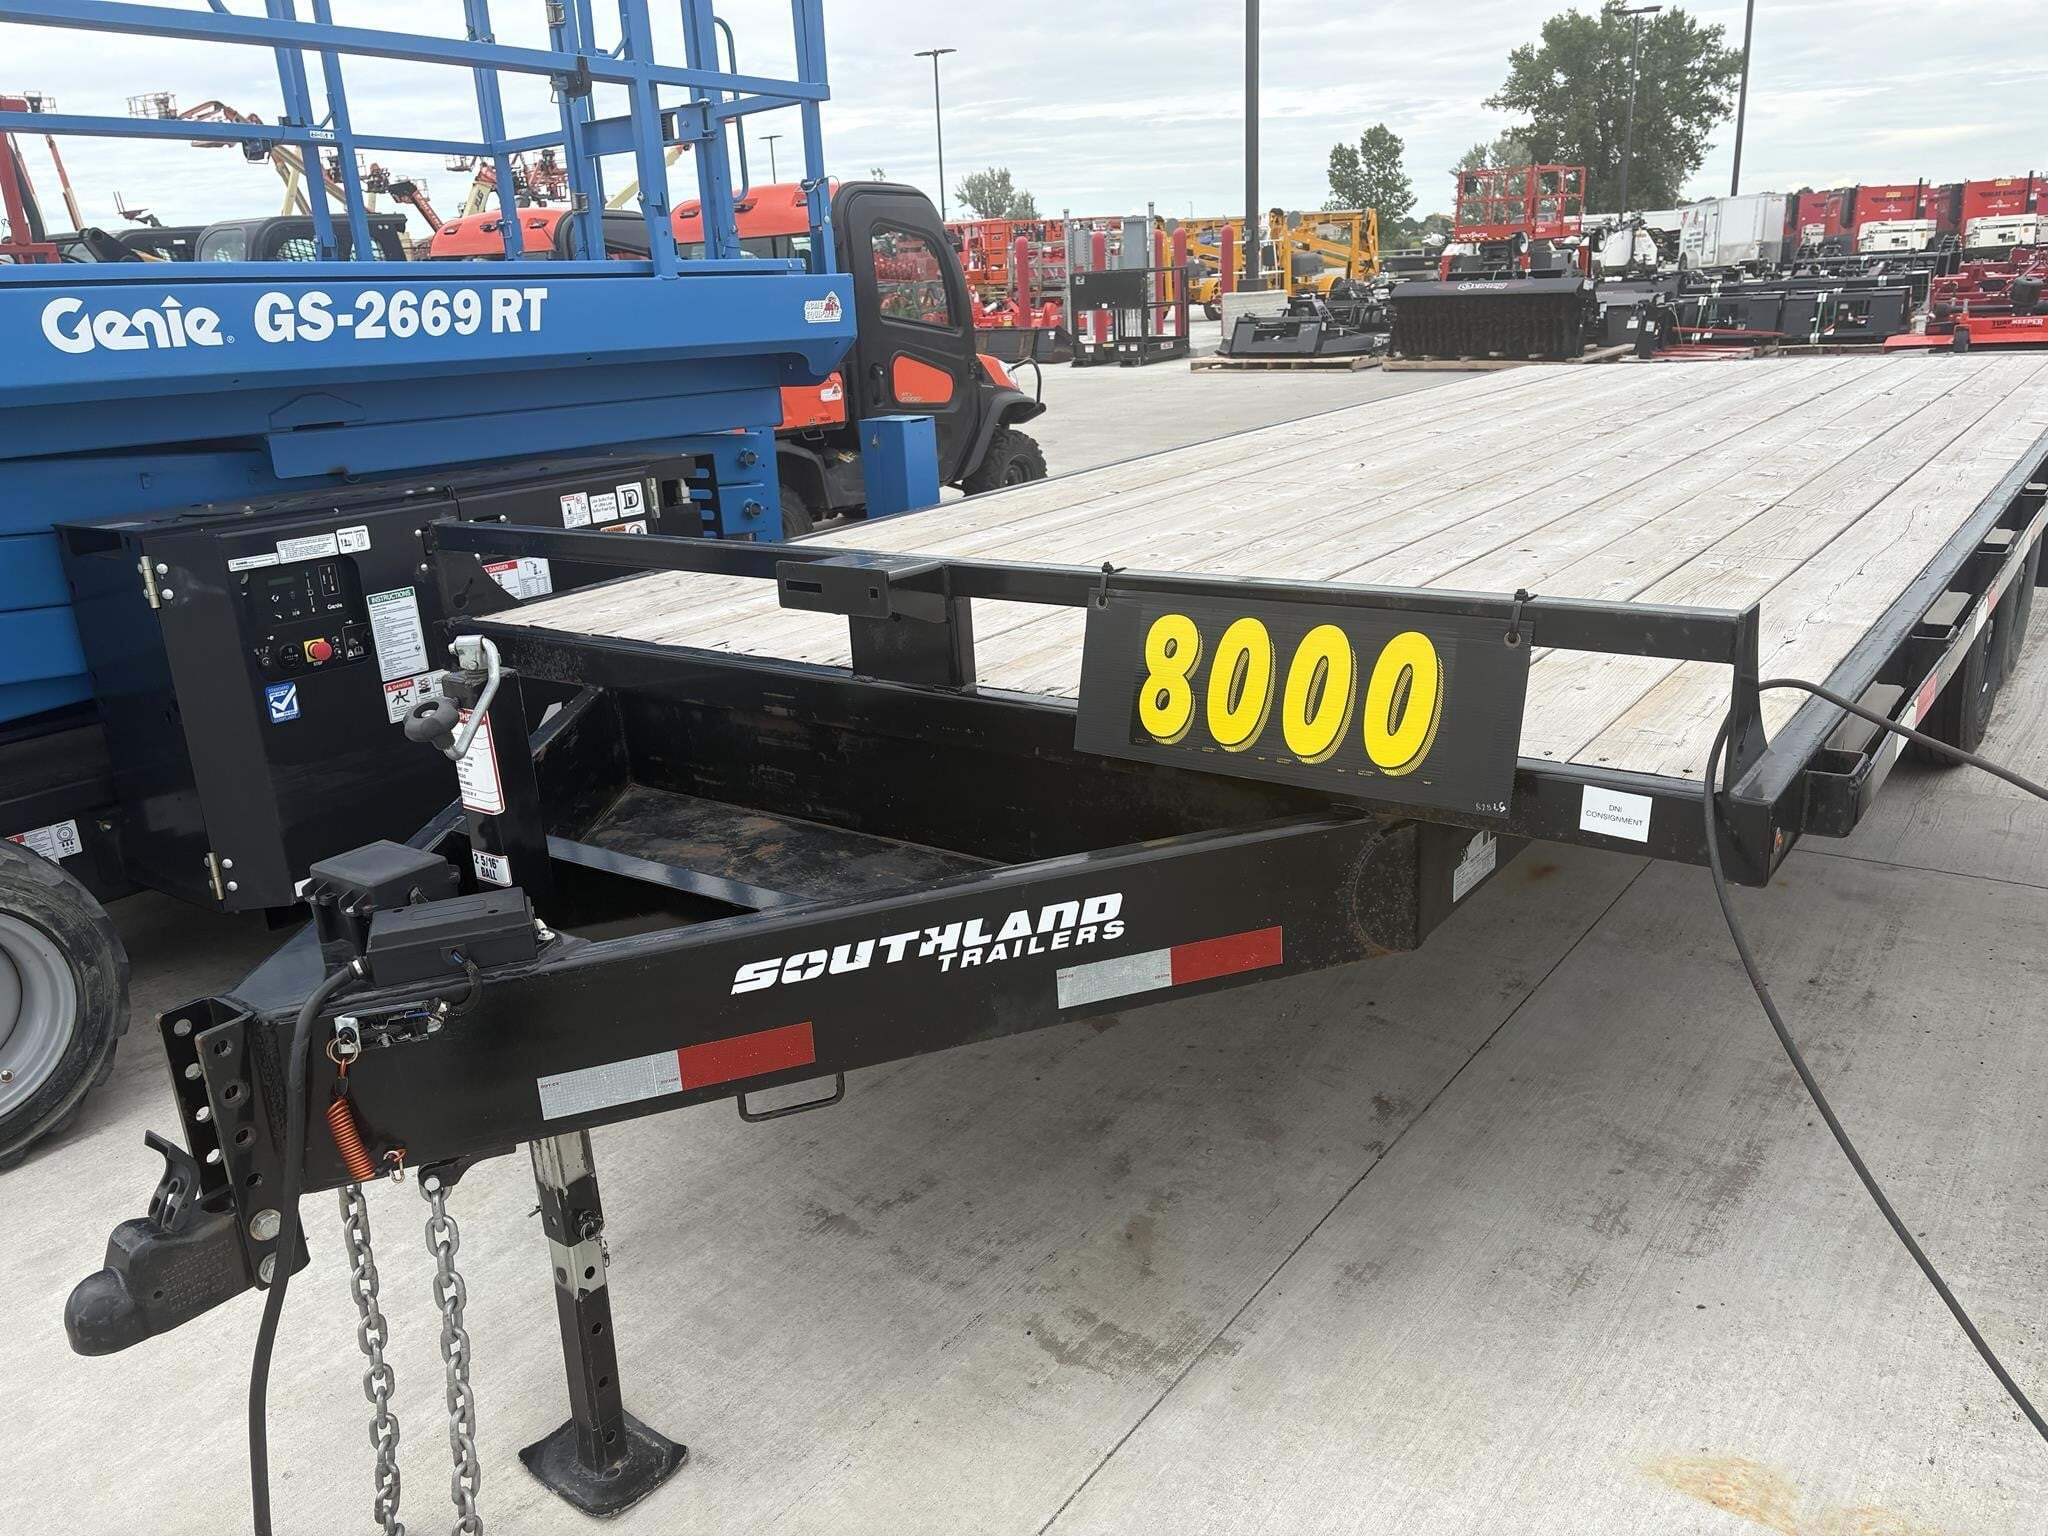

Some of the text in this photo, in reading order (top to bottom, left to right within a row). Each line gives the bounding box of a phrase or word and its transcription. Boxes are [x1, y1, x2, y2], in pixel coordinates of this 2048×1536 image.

[41, 287, 548, 354] Genie GS-2669 RT
[371, 589, 412, 604] INSTRUCTIONS
[1138, 613, 1446, 777] 8000
[1585, 810, 1643, 827] CONSIGNMENT
[474, 853, 480, 864] 2
[481, 867, 498, 881] BALL
[730, 892, 1124, 996] SOUTHLAND
[938, 919, 1126, 973] TRAILERS
